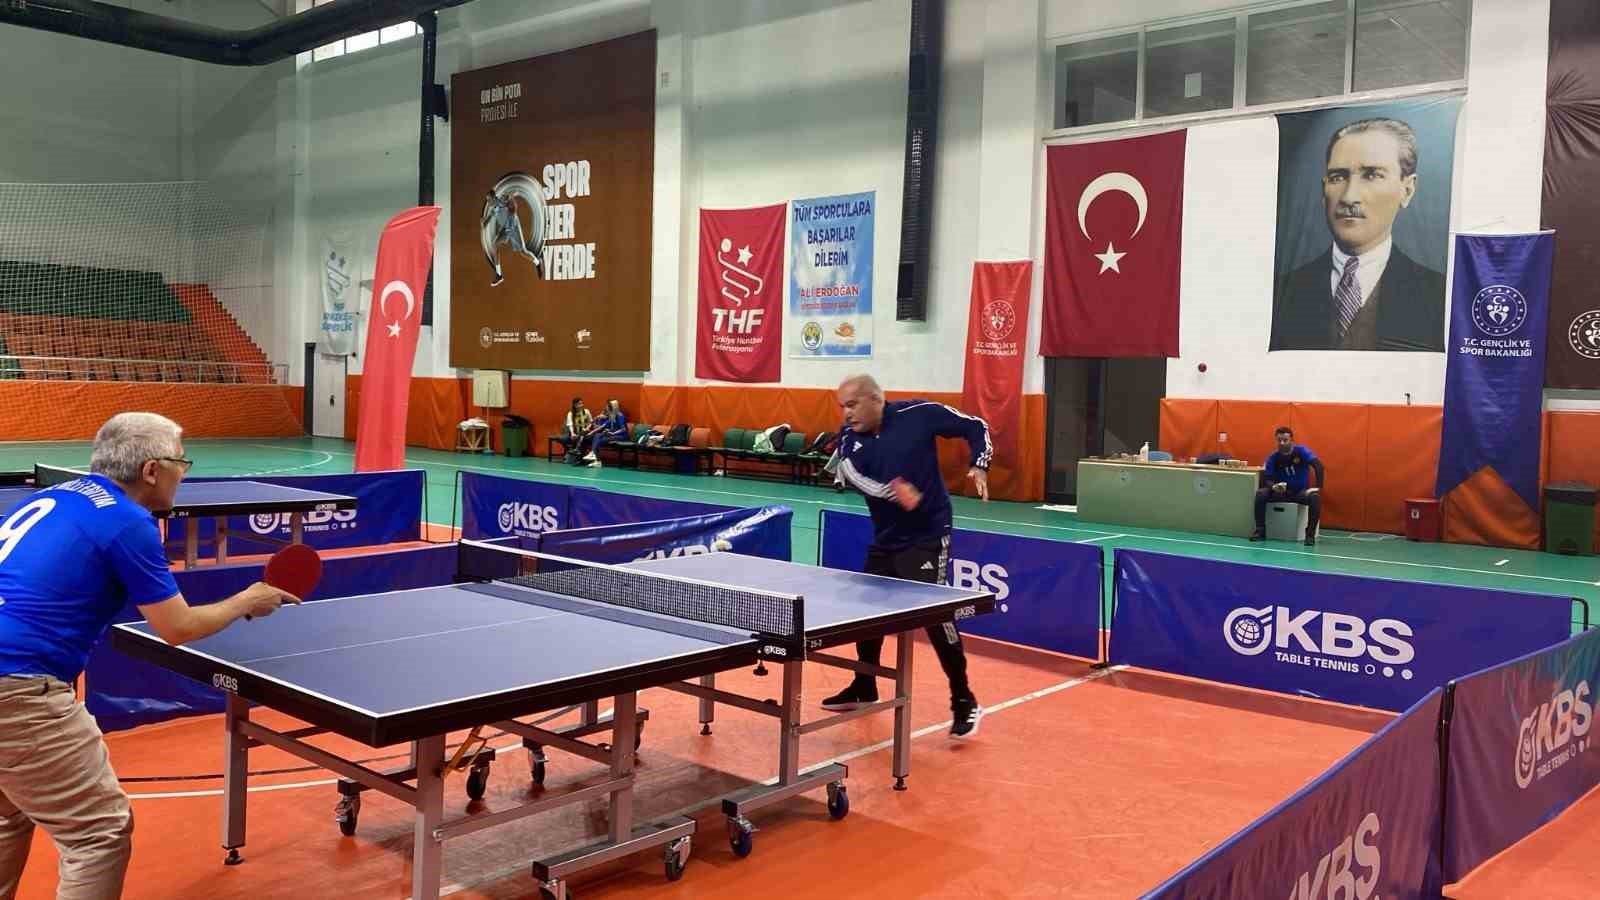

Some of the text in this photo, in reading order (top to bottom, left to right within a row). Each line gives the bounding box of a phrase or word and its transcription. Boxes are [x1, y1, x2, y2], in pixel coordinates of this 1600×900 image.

[543, 160, 591, 200] SPOR
[795, 200, 871, 222] TÜM SPORCULARA
[807, 226, 855, 246] BAŞARILAR
[543, 243, 596, 280] YERDE
[814, 248, 848, 268] DİLERİM
[712, 308, 765, 334] THF
[1459, 346, 1533, 357] SPOR BAKANLIĞI
[1464, 337, 1531, 348] T.C. GENÇLİK VE
[513, 502, 558, 532] KBS
[945, 558, 1010, 601] BS
[1275, 605, 1415, 665] KBS
[770, 645, 787, 656] KBS
[1275, 651, 1360, 673] TABLE TENNIS
[219, 673, 238, 691] KBS
[1536, 680, 1593, 761] KBS
